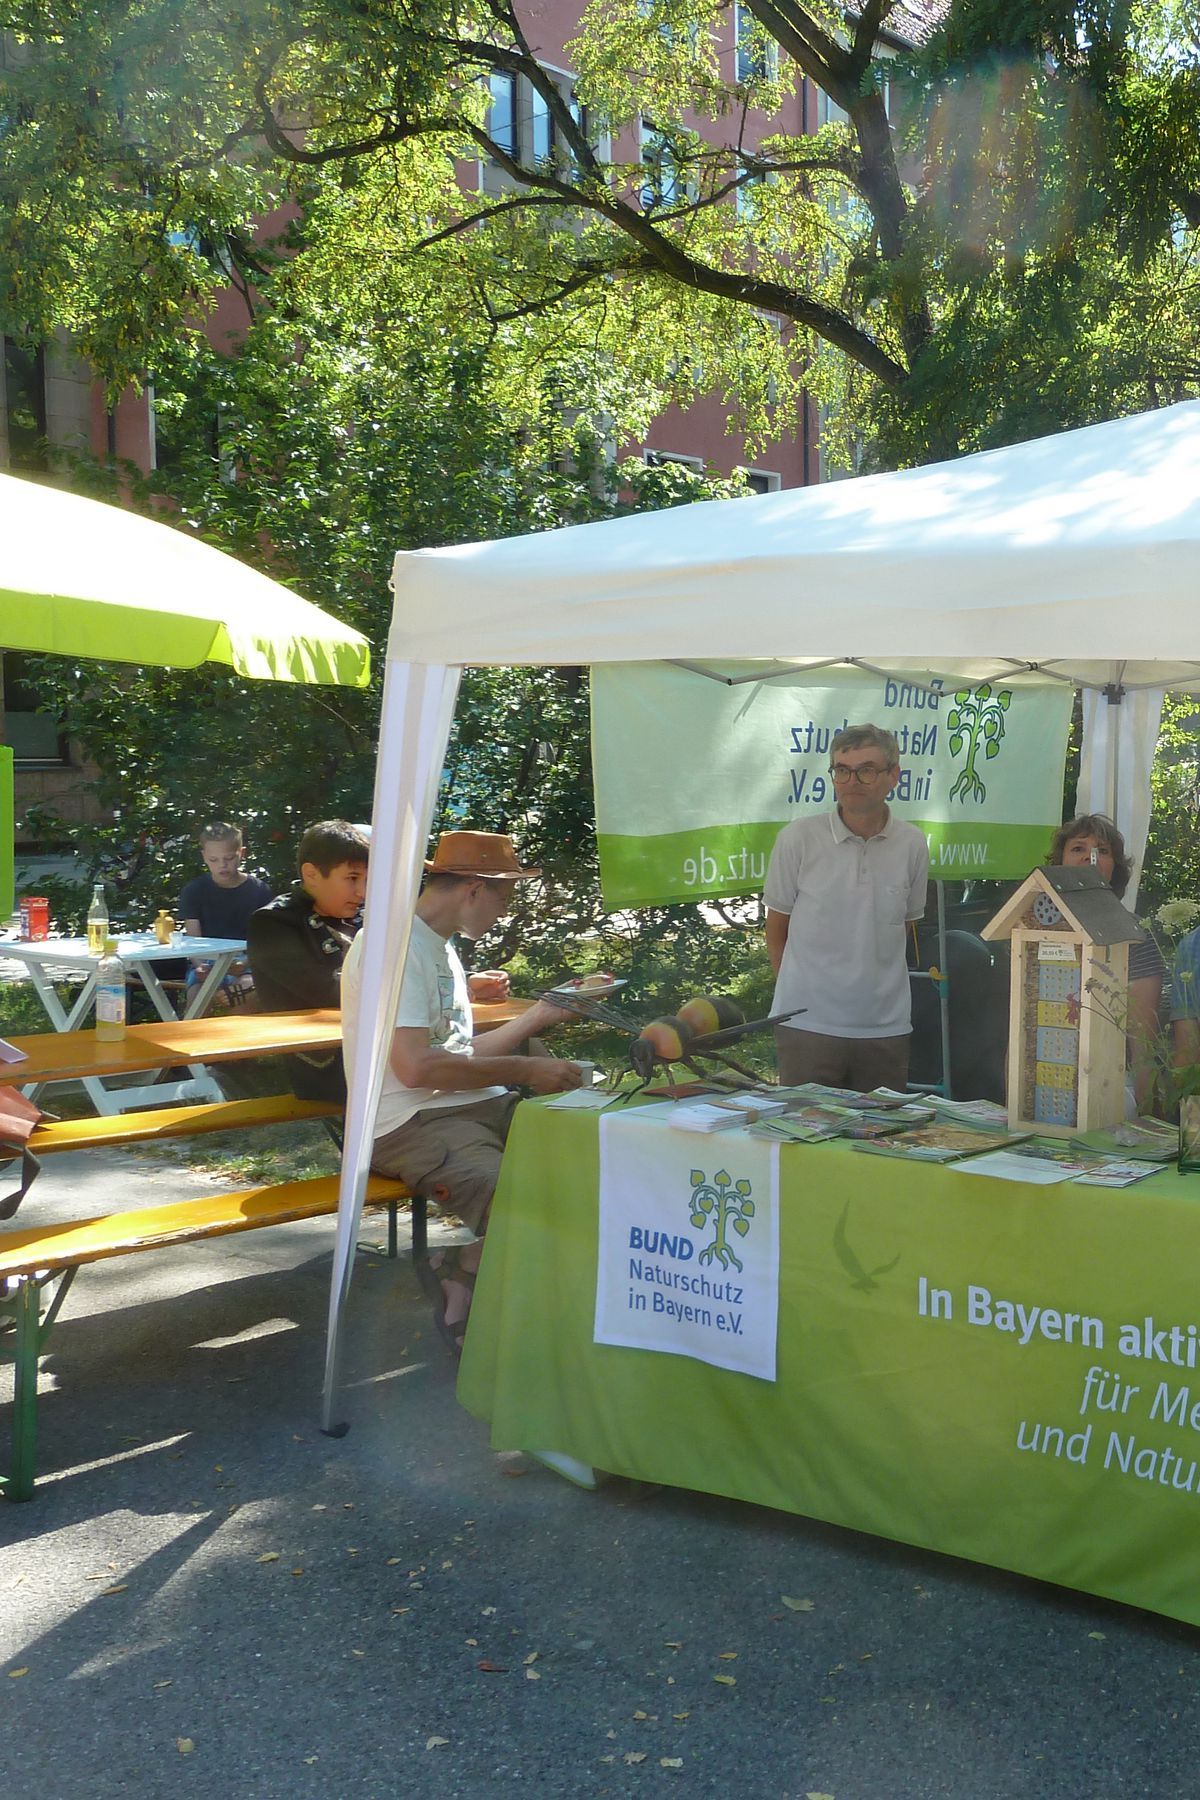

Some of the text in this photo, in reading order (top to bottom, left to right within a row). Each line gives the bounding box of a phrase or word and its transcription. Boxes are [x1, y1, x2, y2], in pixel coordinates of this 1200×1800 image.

[629, 1226, 694, 1261] BUND
[629, 1258, 744, 1305] Naturschutz
[628, 1287, 744, 1336] in Bayern e.V.
[918, 1277, 953, 1320] In
[967, 1285, 1104, 1349] Bayern
[1079, 1366, 1141, 1415] für
[1016, 1420, 1093, 1465] und
